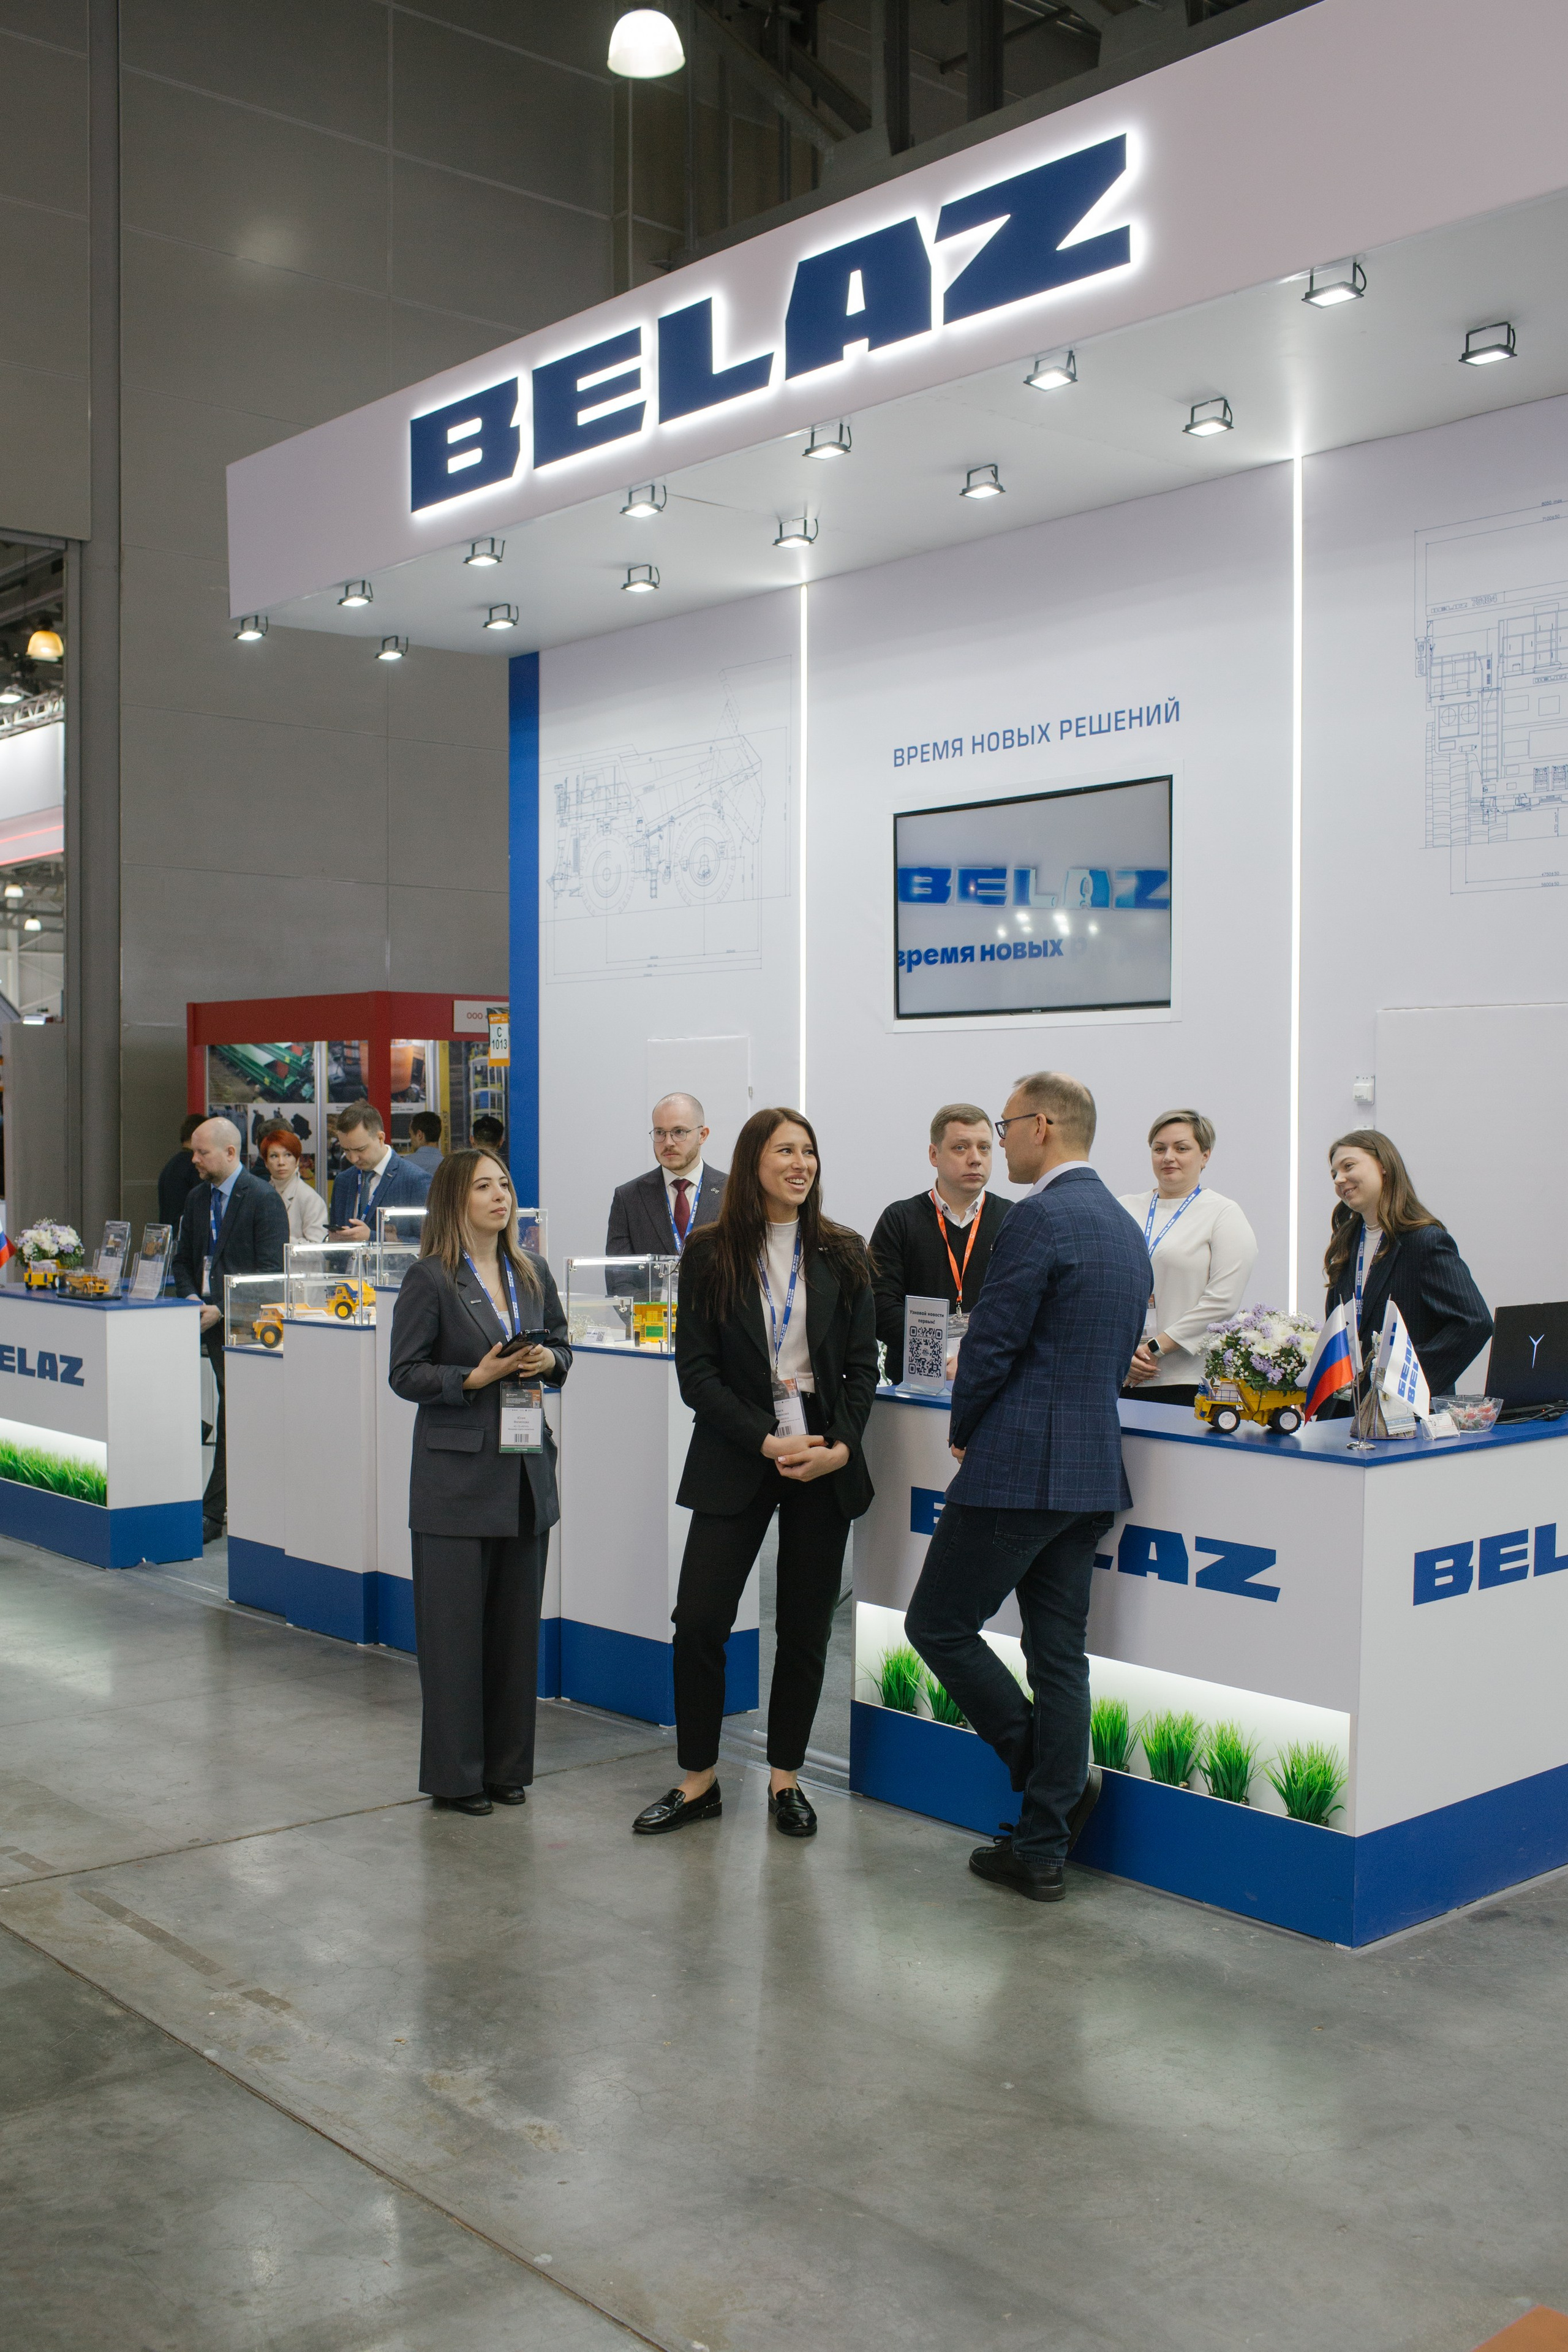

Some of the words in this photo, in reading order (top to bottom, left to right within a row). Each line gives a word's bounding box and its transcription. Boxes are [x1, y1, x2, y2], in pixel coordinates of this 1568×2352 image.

[410, 133, 1131, 513] BELAZ
[893, 737, 963, 767] ВРЕМЯ
[972, 723, 1050, 755] НОВЫХ
[1060, 696, 1180, 741] РЕШЕНИЙ
[897, 866, 1170, 910] BELAZ
[981, 938, 1064, 962] новых
[491, 1039, 508, 1050] 1013
[1179, 1193, 1196, 1213] BELAZ
[1412, 1523, 1568, 1606] BEL
